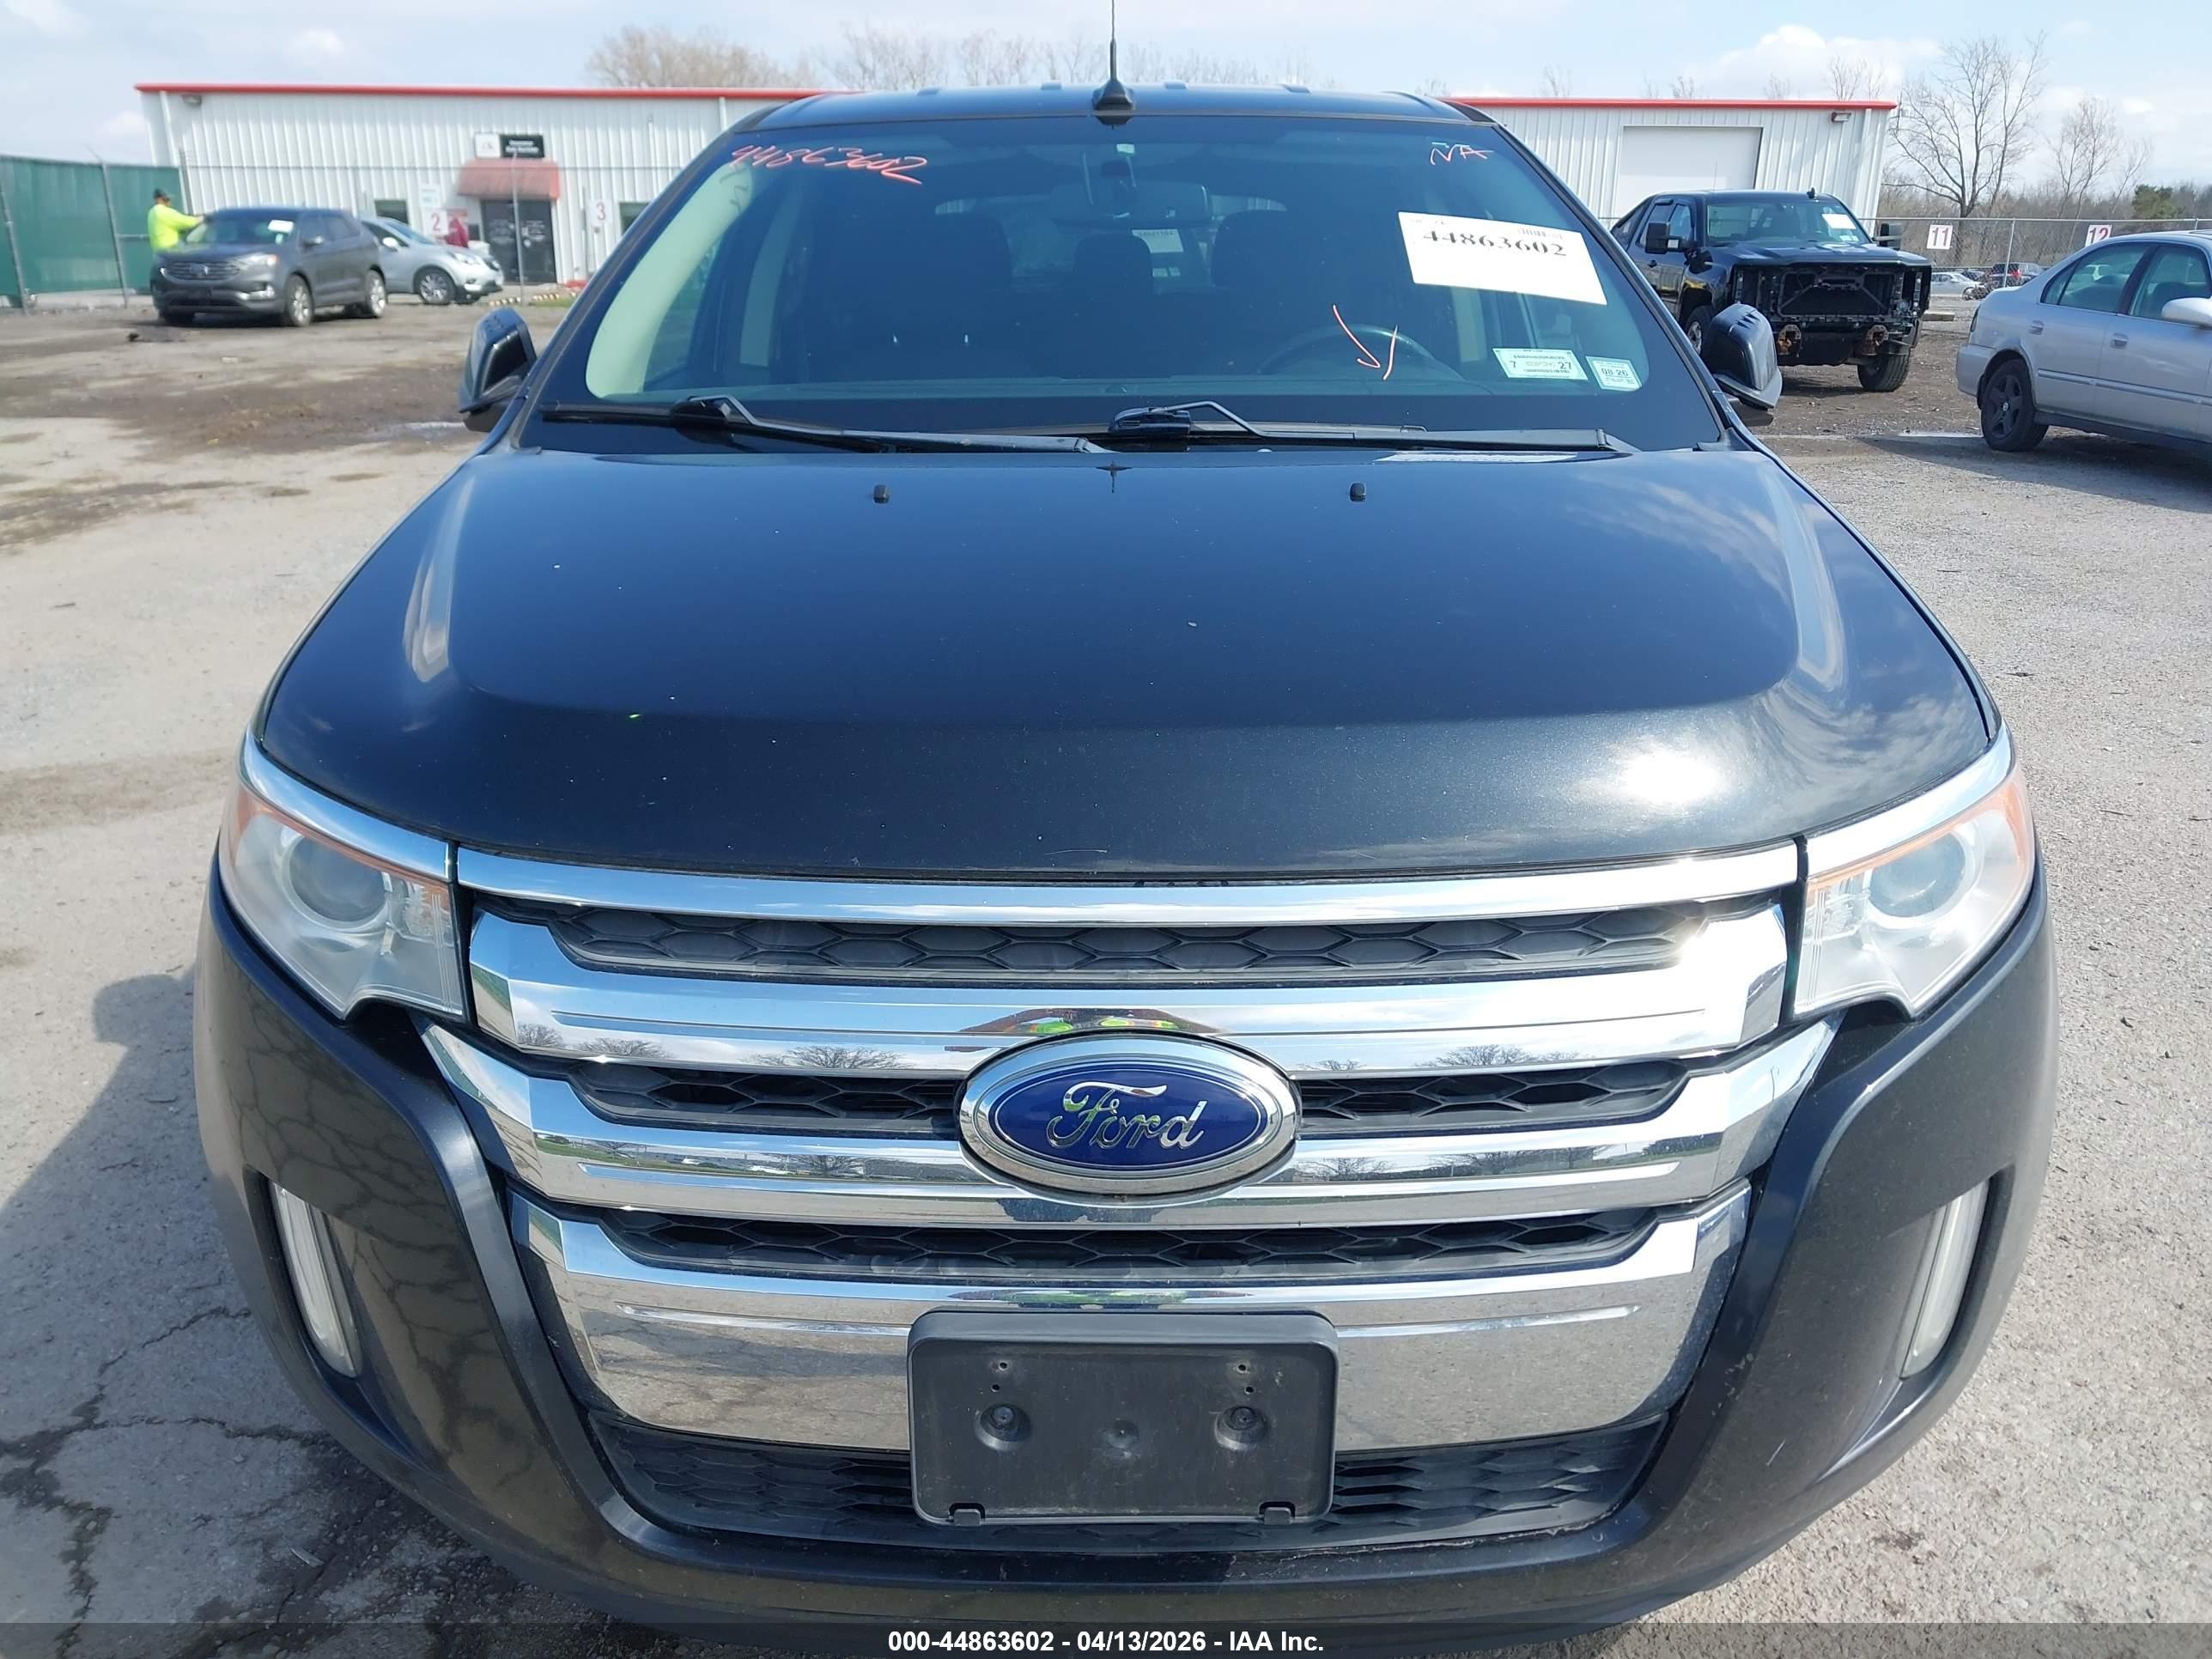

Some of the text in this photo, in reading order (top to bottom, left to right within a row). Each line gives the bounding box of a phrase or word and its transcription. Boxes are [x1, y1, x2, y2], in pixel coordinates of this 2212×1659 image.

[595, 202, 606, 221] 3
[430, 212, 441, 232] 2
[1423, 230, 1567, 256] 44863602
[1931, 227, 1950, 247] 11
[1046, 1080, 1207, 1149] Ford
